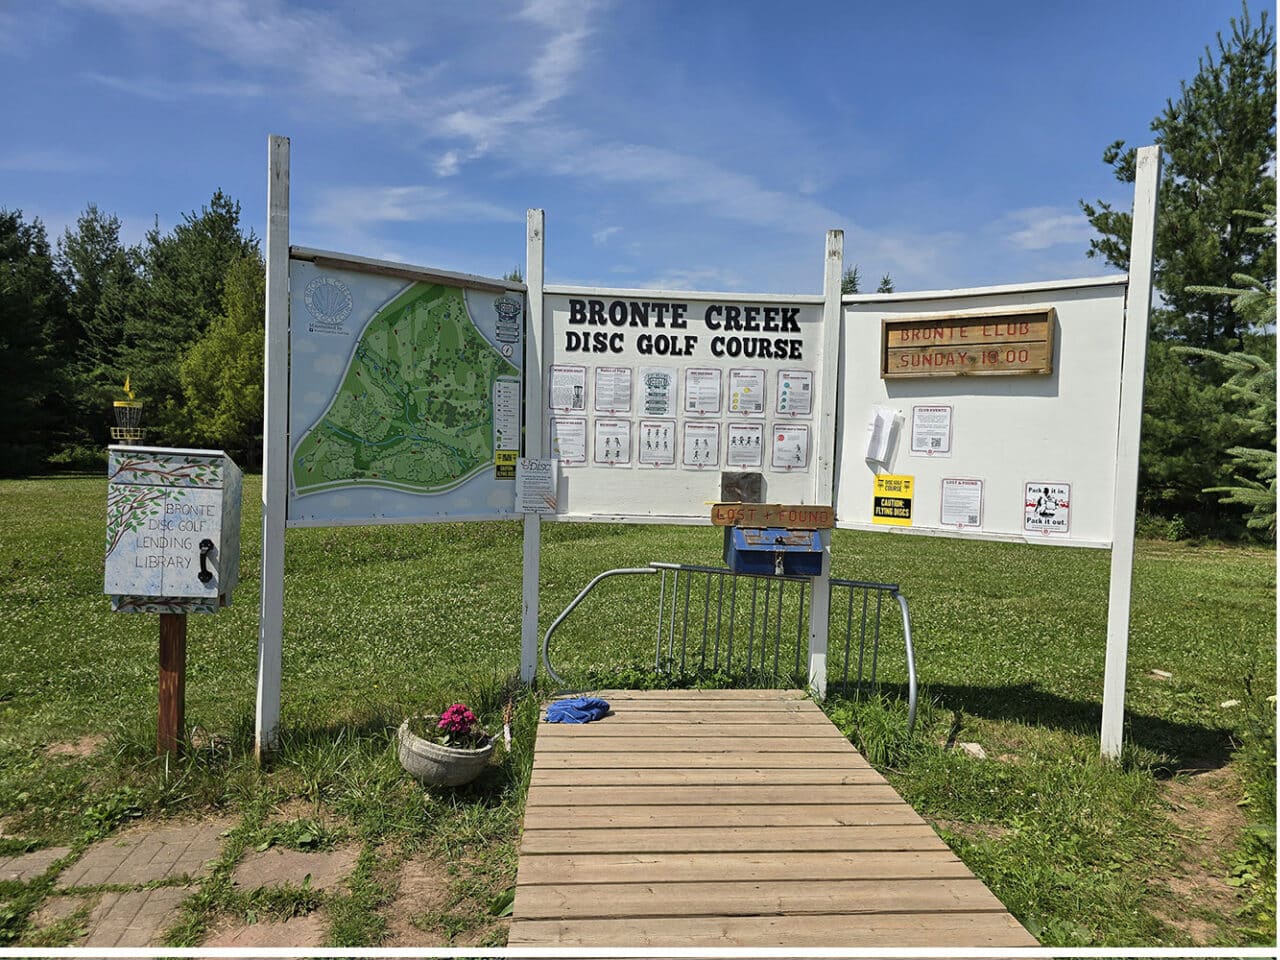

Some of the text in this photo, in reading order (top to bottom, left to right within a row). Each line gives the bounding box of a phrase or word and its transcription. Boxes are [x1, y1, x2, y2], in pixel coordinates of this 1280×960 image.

[568, 299, 801, 332] BRONTE CREEK
[982, 321, 1030, 337] CLUB
[565, 331, 803, 361] DISC GOLF COURSE
[900, 351, 968, 368] SUNDAY
[166, 503, 215, 516] BRONTE
[716, 508, 828, 523] LOST + FOUND
[148, 518, 207, 532] DISC GOLF
[136, 536, 193, 550] LENDING
[135, 555, 192, 569] LIBRARY
